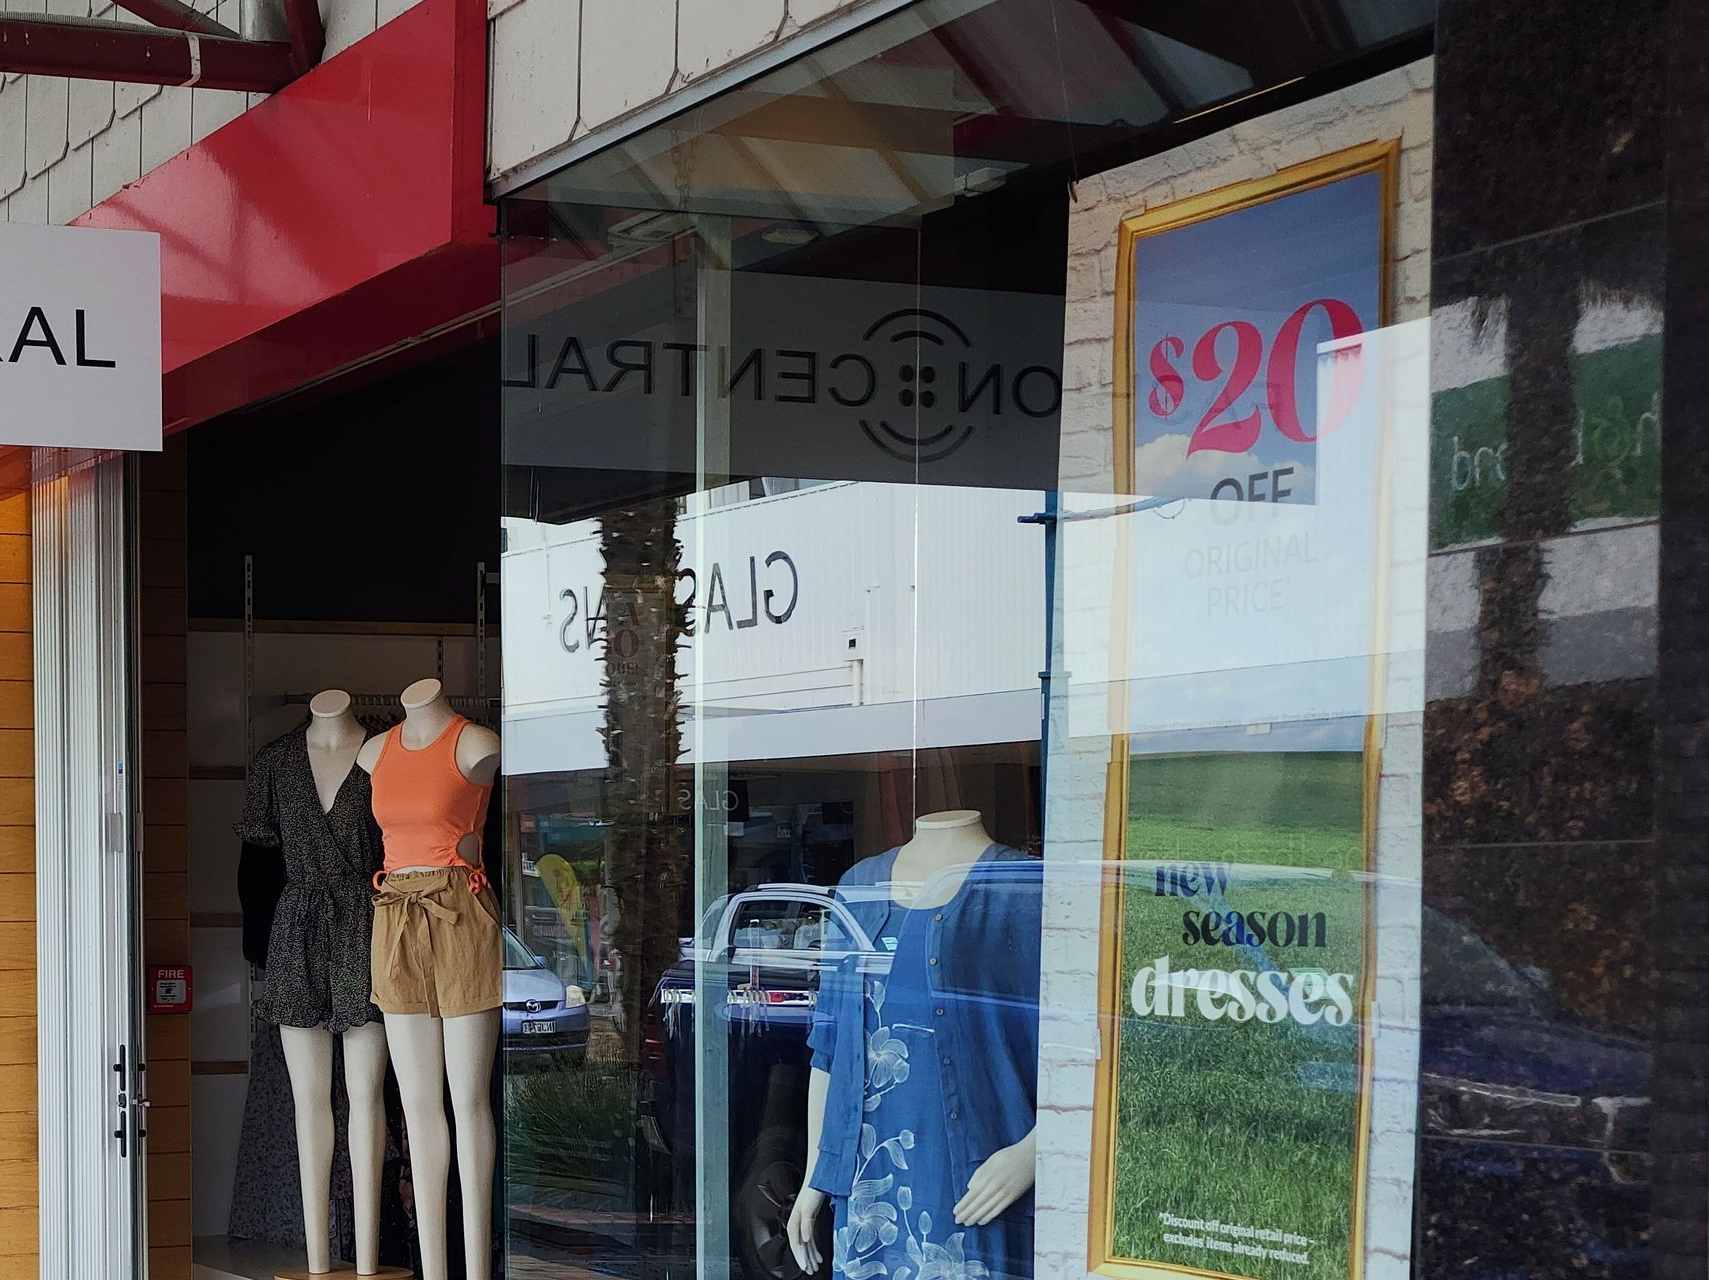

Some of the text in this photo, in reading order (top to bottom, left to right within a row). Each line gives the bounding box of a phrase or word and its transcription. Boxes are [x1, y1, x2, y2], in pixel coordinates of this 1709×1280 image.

[1147, 298, 1366, 460] $20
[1208, 466, 1295, 527] OFF
[1184, 530, 1318, 580] ORIGINAL
[1154, 862, 1232, 897] new
[1181, 910, 1327, 948] season
[157, 969, 185, 979] FIRE
[1130, 954, 1354, 1026] dresses
[1163, 1231, 1203, 1249] excludes
[1220, 1222, 1254, 1239] original
[1284, 1231, 1307, 1247] price
